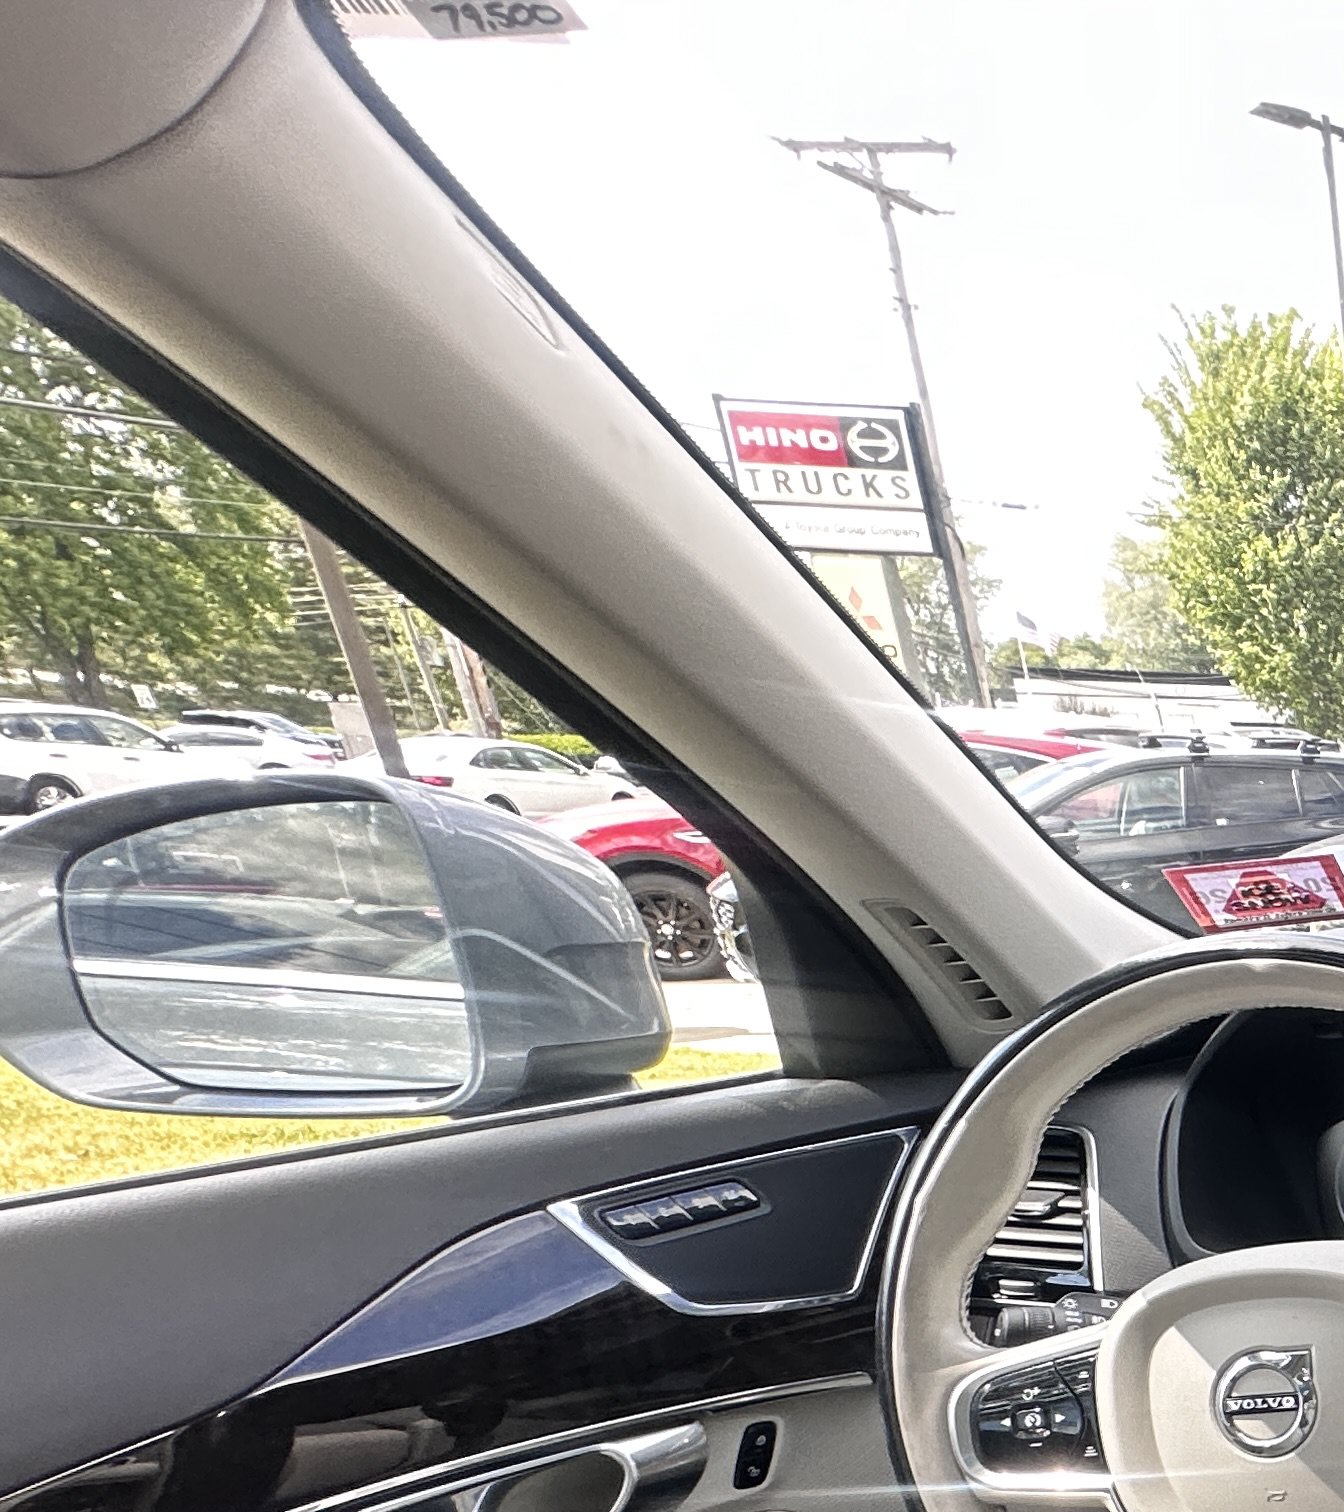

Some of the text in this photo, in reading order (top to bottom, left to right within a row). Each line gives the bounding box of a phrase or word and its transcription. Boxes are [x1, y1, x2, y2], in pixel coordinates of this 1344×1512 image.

[736, 426, 839, 451] HINO
[744, 468, 910, 500] TRUCKS
[871, 524, 920, 538] Company
[1226, 1396, 1296, 1411] VOLVO
